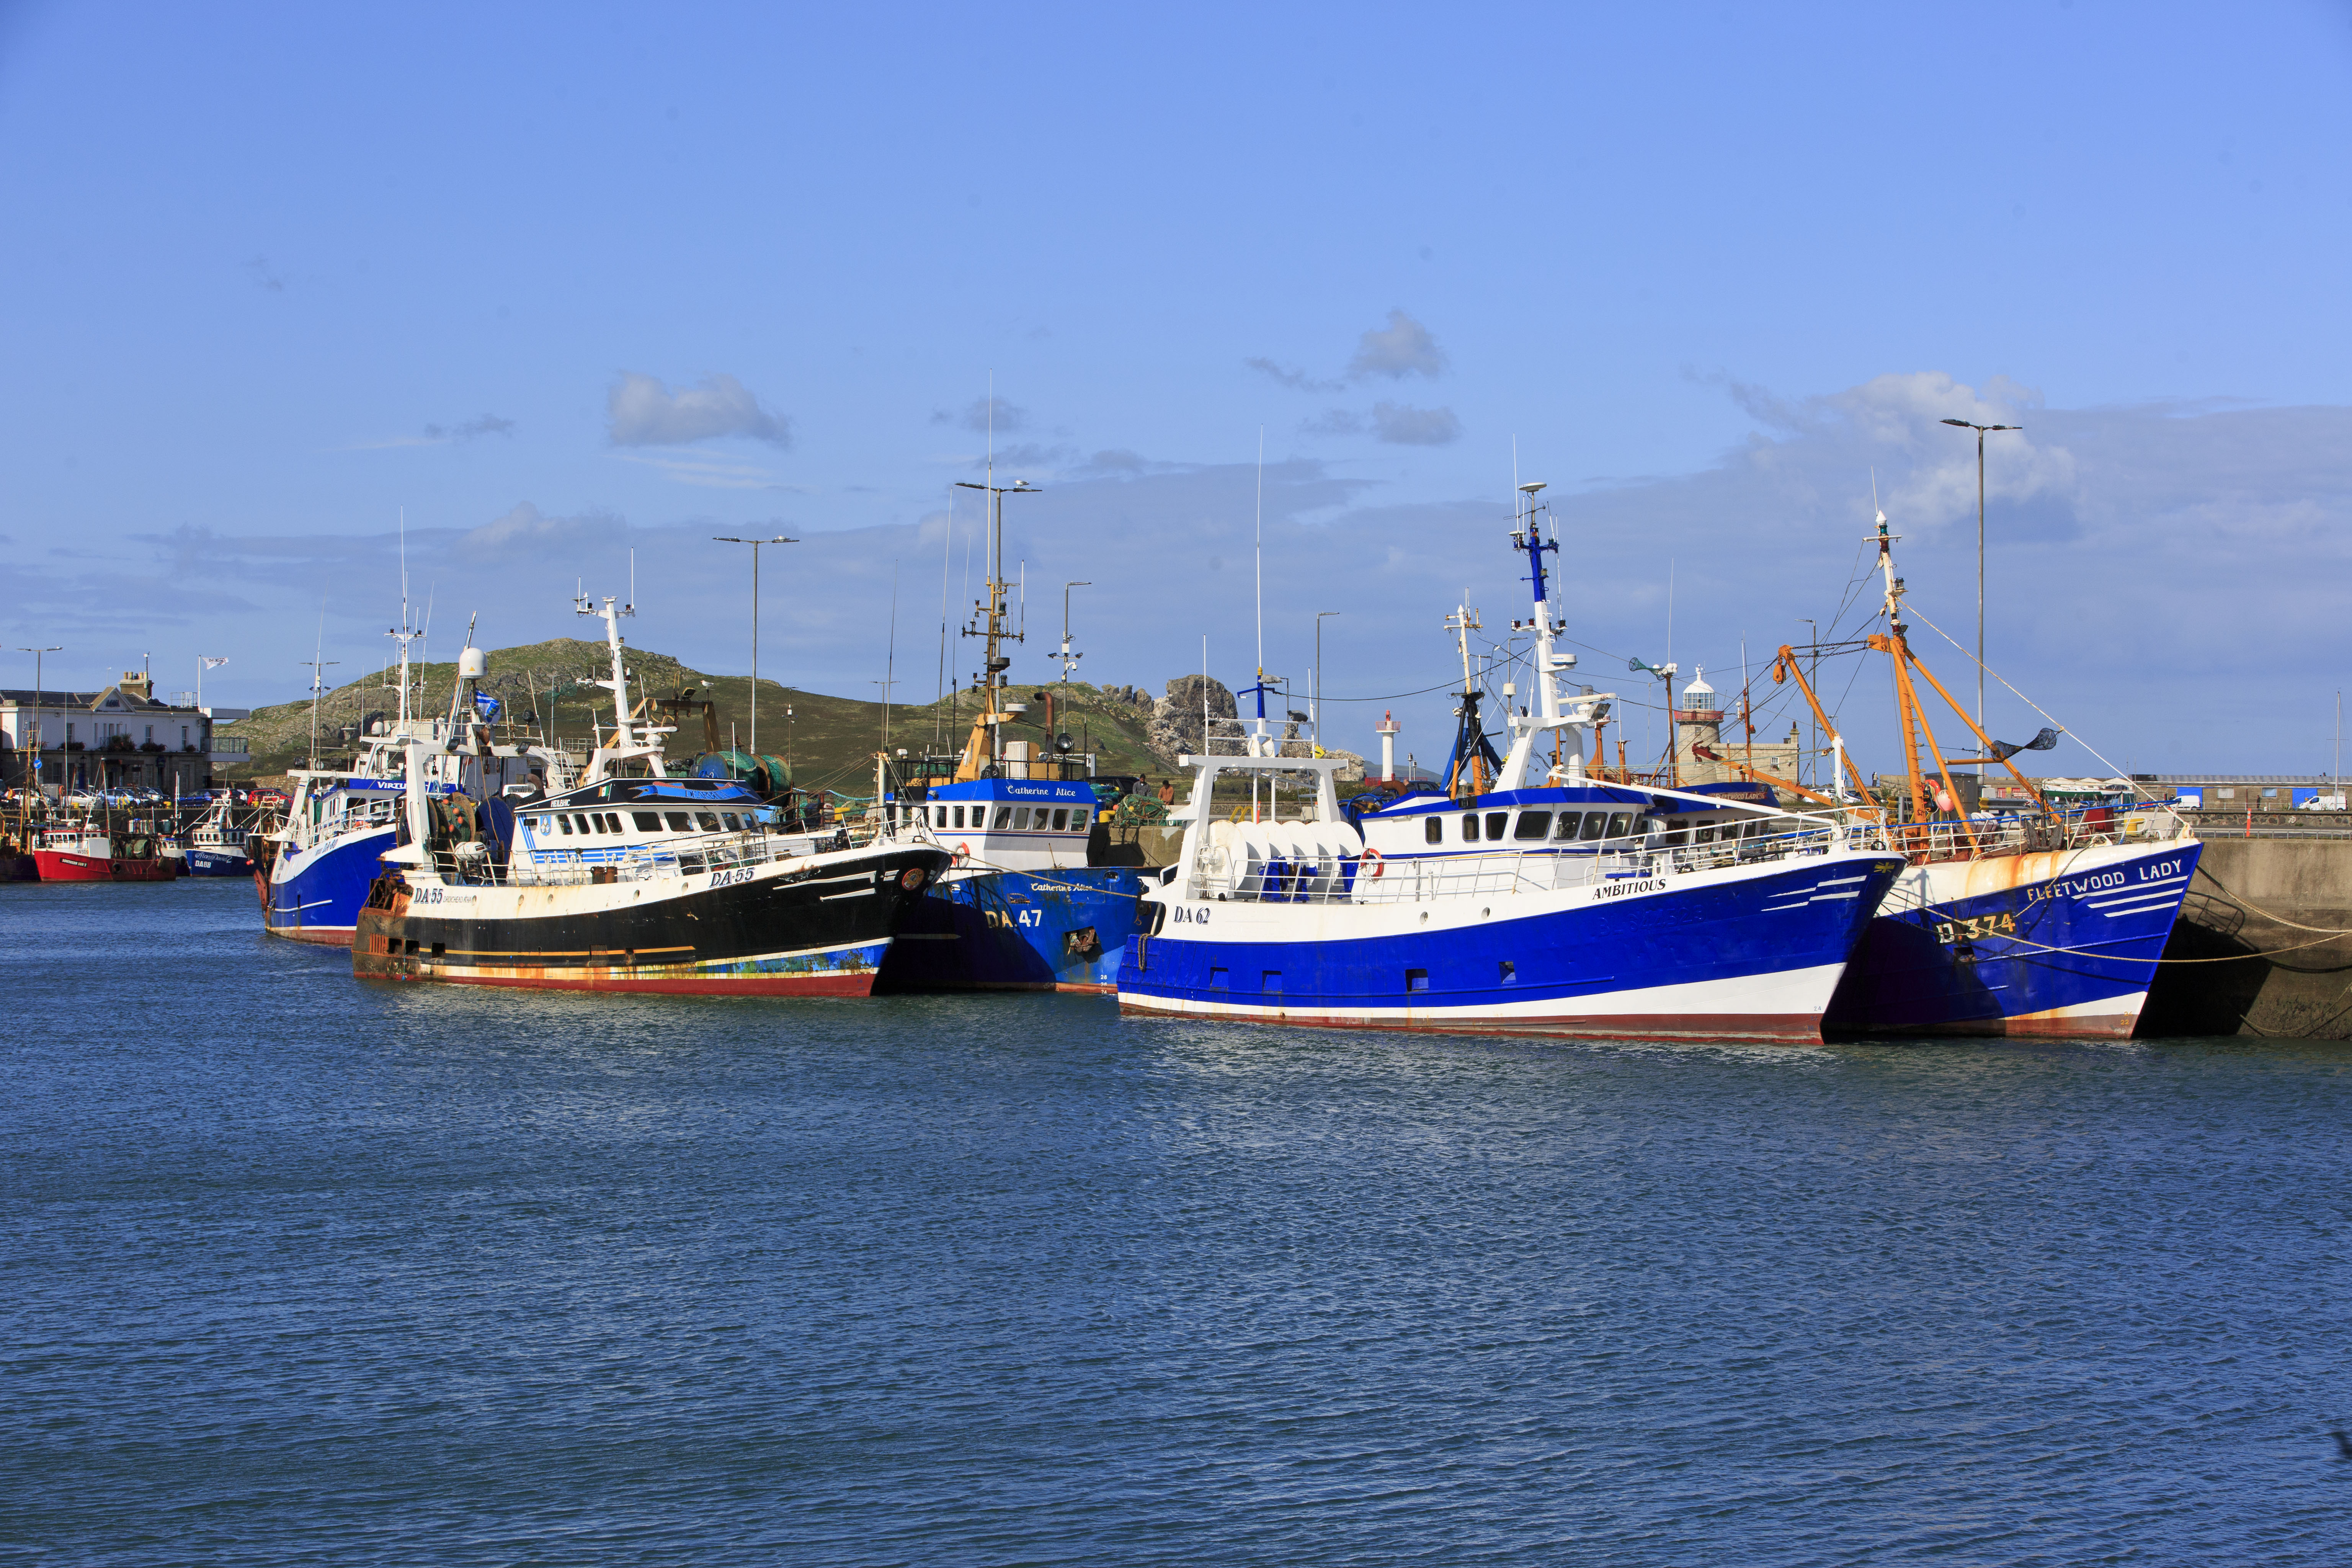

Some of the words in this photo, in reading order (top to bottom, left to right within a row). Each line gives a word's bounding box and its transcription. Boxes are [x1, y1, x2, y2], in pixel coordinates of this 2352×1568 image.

[1006, 785, 1049, 795] Catherine
[1055, 787, 1076, 797] Alice
[550, 799, 570, 808] HEILBHIC
[226, 856, 233, 864] 2
[2027, 871, 2125, 901] FLEETWOOD
[2139, 859, 2181, 881] LADY
[1031, 883, 1072, 892] Catherine
[1592, 879, 1666, 900] AMBITIOUS
[1173, 905, 1192, 923] DA
[1196, 907, 1210, 924] 62
